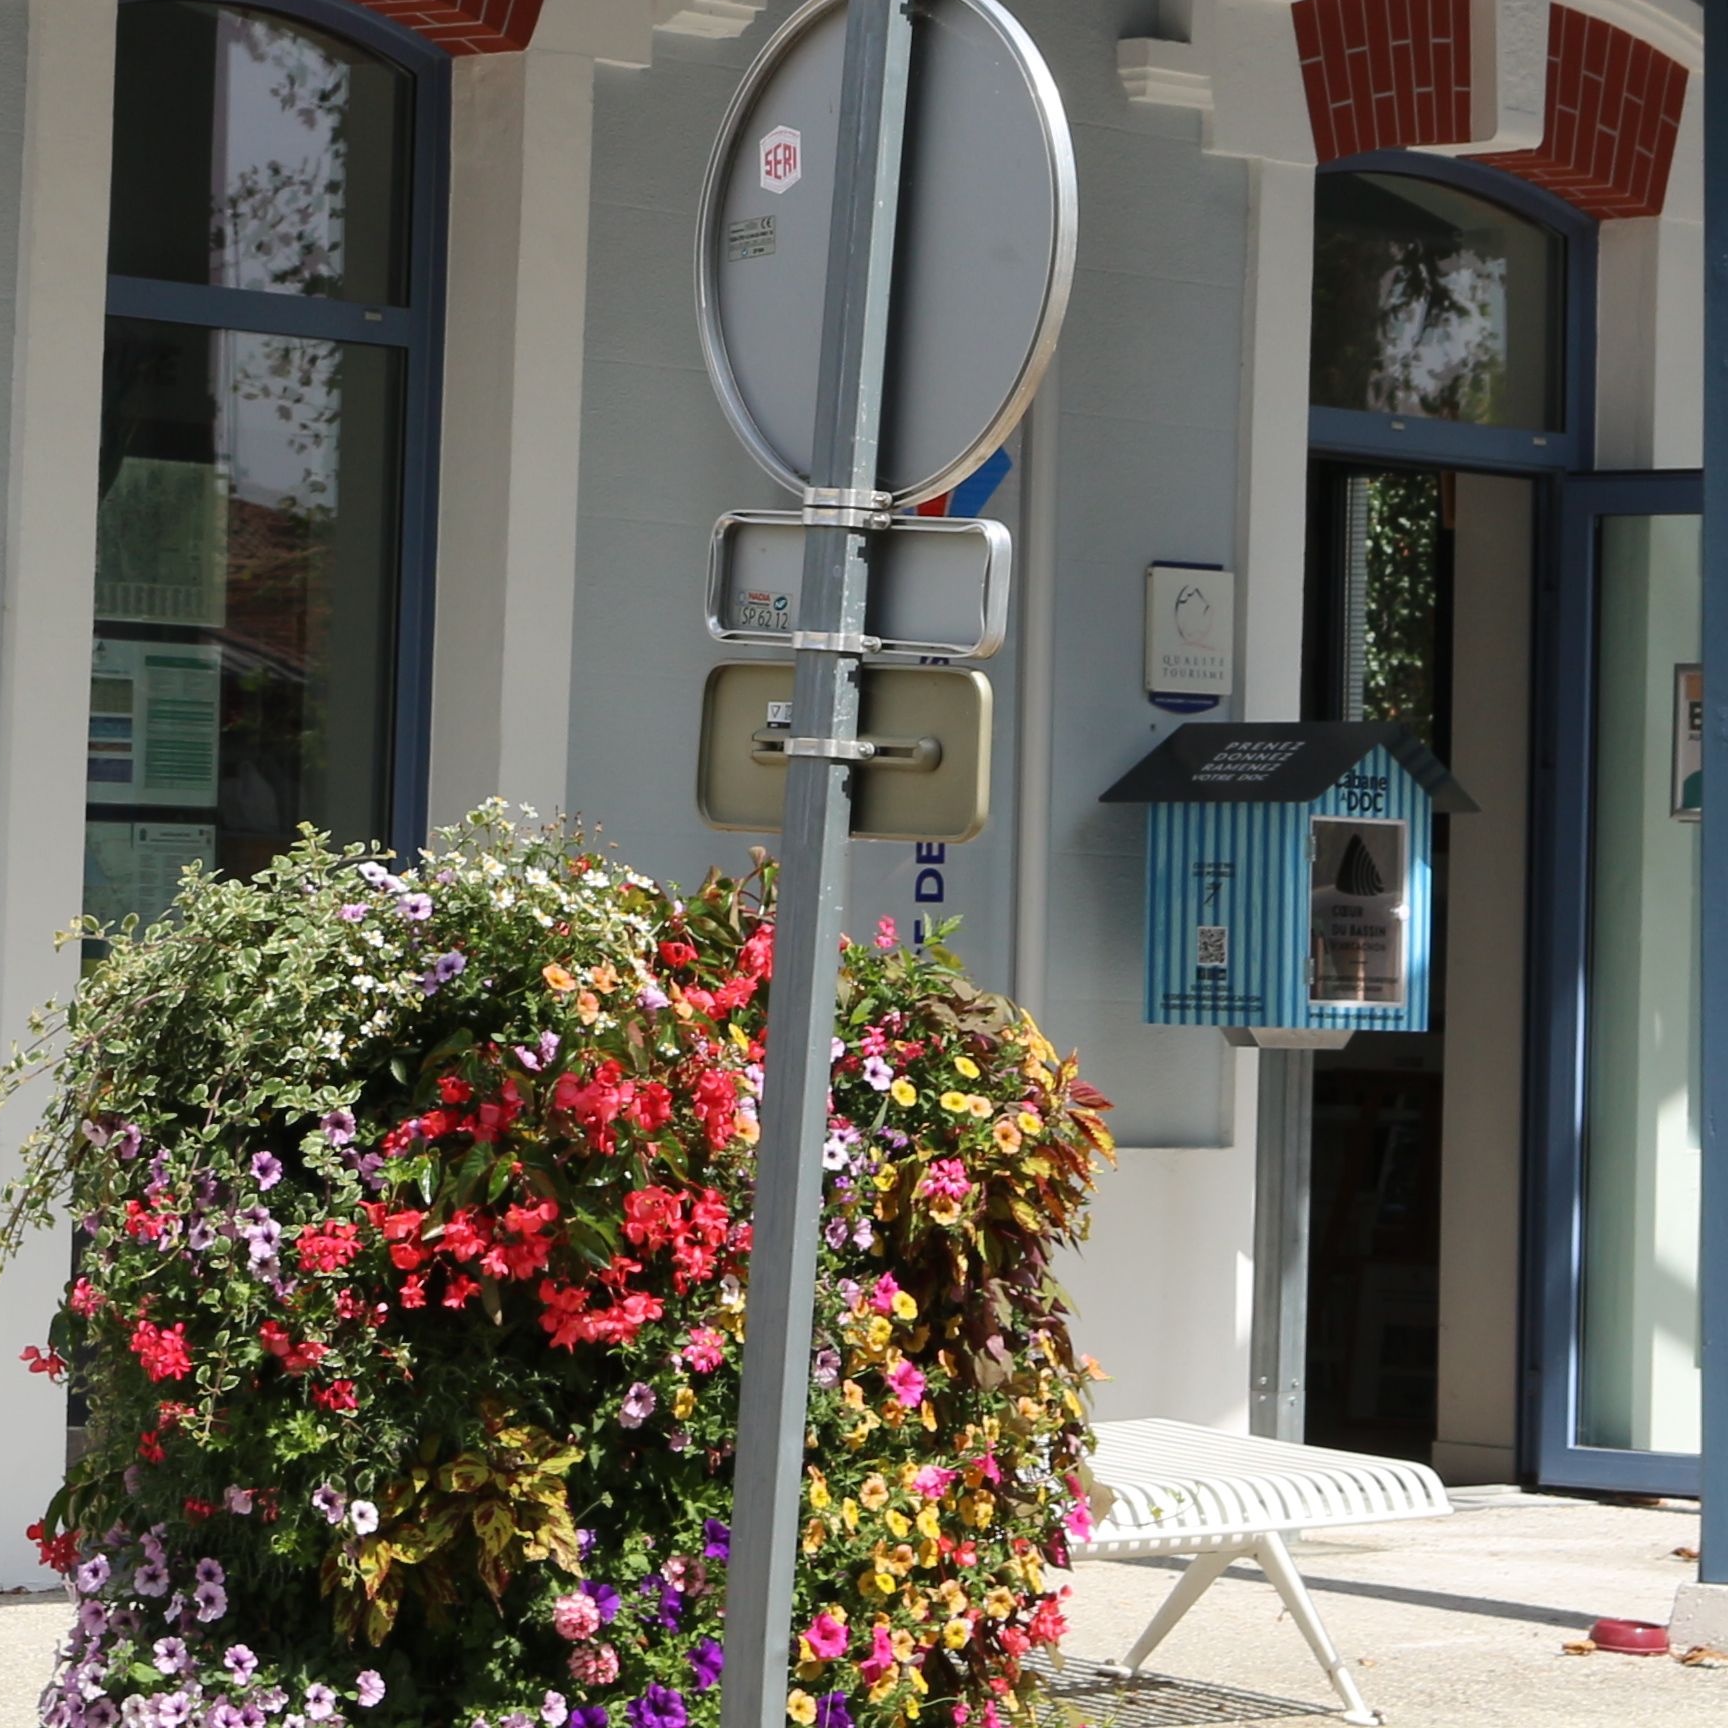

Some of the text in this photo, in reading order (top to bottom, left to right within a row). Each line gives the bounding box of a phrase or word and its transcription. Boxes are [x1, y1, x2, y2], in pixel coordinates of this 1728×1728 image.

[765, 143, 797, 180] SERI
[742, 606, 789, 630] SP 62 12
[1162, 667, 1224, 680] TOURISME
[1225, 741, 1306, 751] PRENEZ
[1213, 752, 1293, 762] DONNEZ
[1201, 763, 1282, 772] RAMENEZ
[1191, 773, 1270, 782] VOTRE DOC
[1347, 790, 1384, 813] DOC
